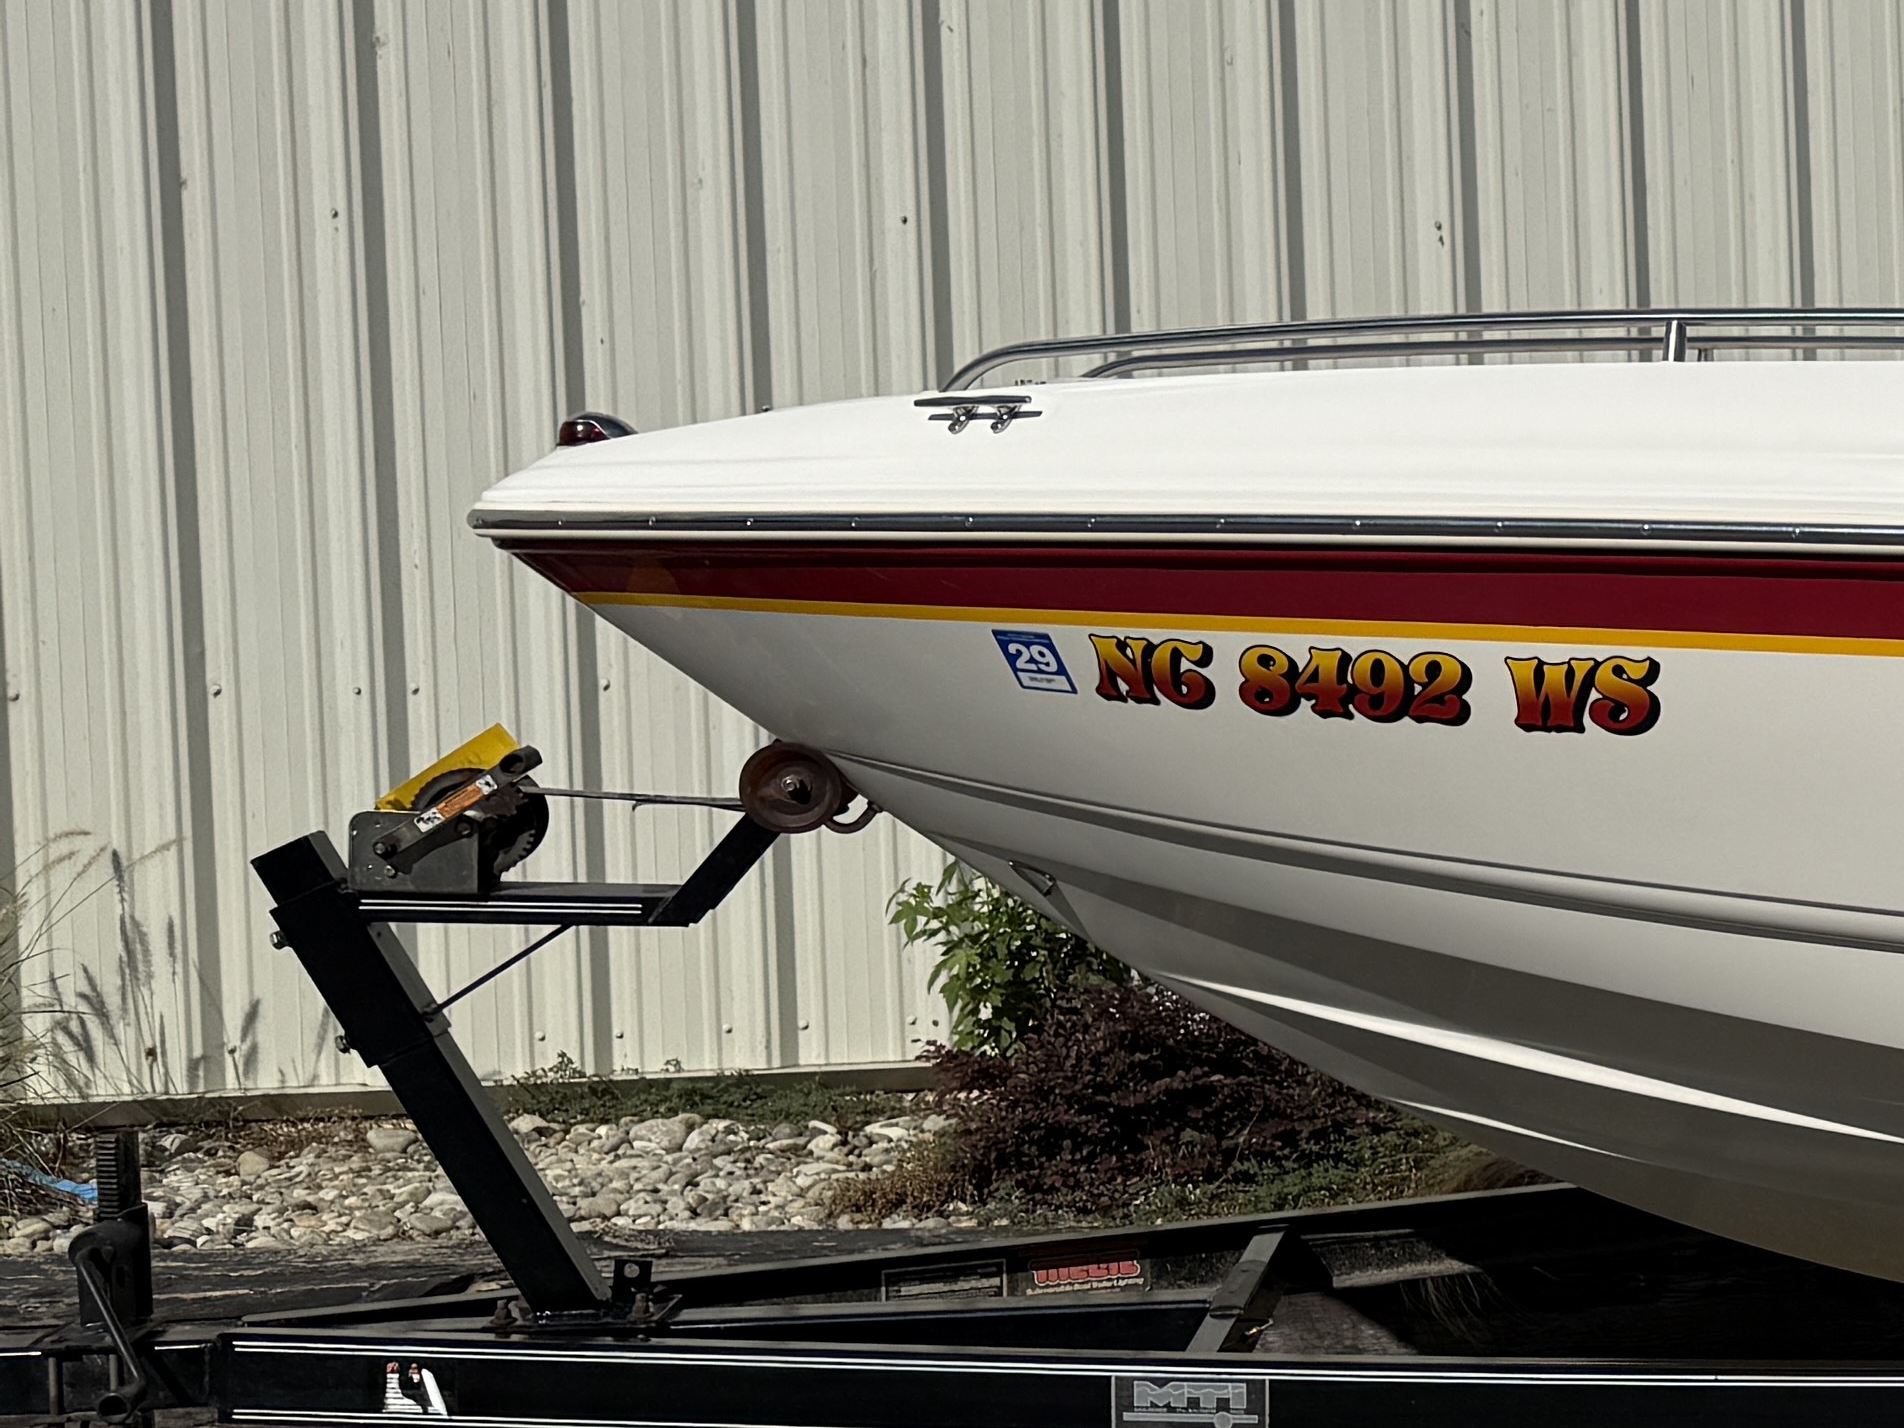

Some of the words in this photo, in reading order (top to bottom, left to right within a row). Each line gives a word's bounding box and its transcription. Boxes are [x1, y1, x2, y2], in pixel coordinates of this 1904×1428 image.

[1007, 642, 1059, 673] 29
[1088, 633, 1216, 710] NC
[1238, 644, 1473, 727] 8492
[1504, 655, 1661, 736] WS
